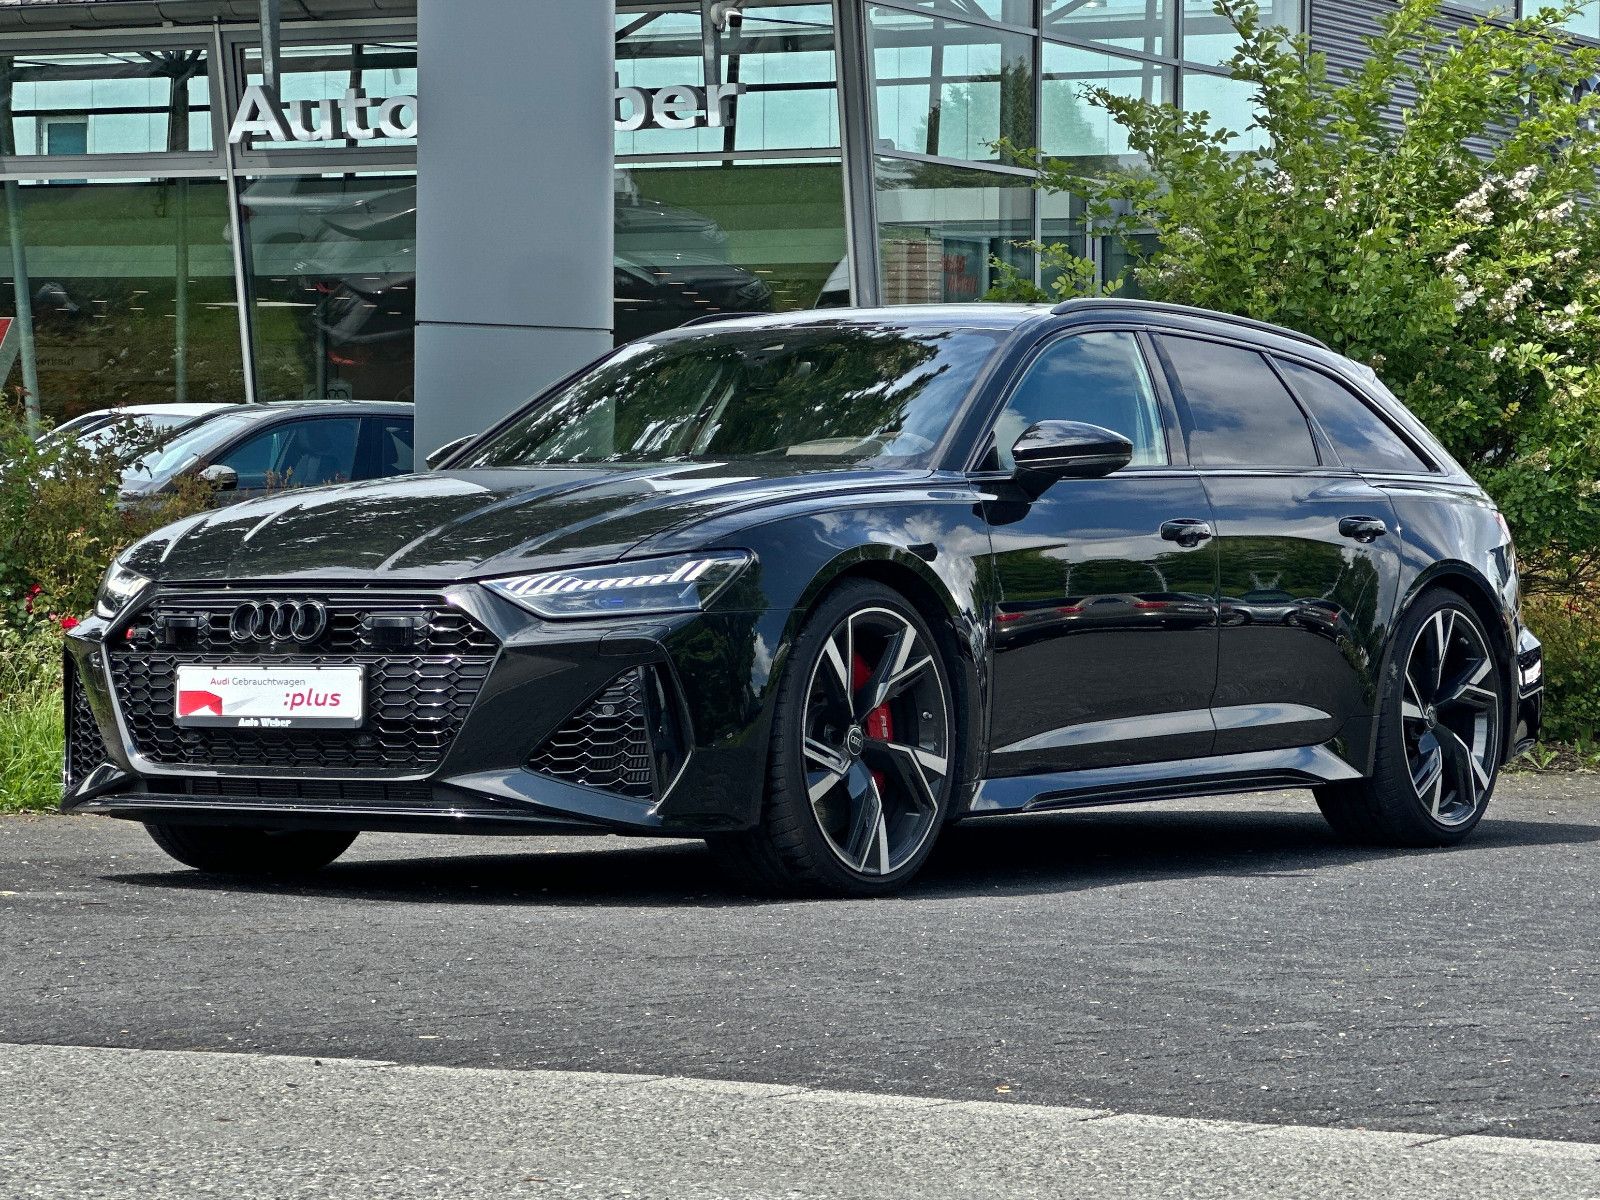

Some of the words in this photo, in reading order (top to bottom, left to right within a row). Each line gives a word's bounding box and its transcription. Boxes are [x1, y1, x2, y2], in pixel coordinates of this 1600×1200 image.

[228, 84, 417, 143] Auto
[210, 677, 230, 686] Audi
[232, 677, 306, 688] Gebrauchtwagen
[283, 688, 341, 710] :plus
[260, 717, 291, 727] Weber
